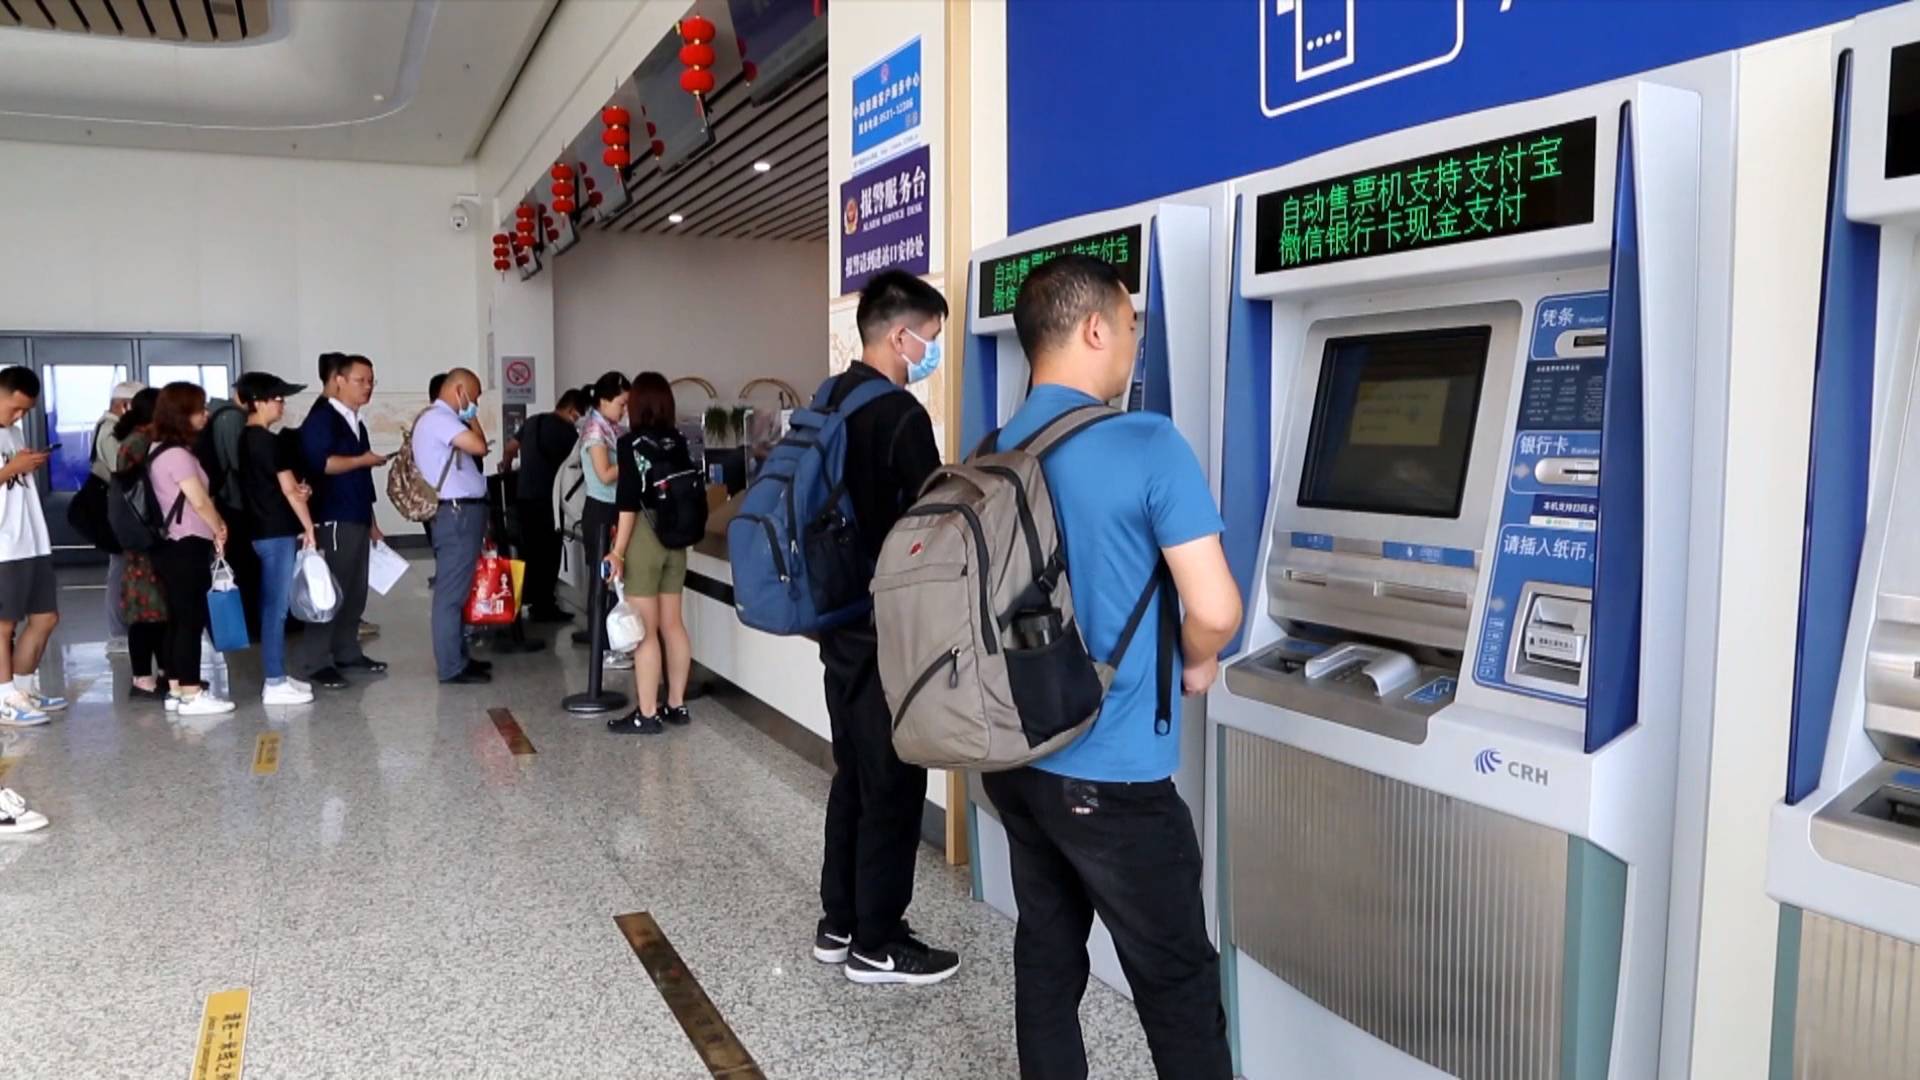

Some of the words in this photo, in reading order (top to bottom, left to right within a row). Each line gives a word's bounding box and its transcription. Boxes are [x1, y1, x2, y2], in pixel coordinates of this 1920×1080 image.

[860, 165, 926, 220] 报警服务台
[1281, 136, 1563, 231] 自动售票机支持支付宝
[882, 208, 905, 225] SERVICE
[1279, 184, 1527, 267] 微信银行卡现金支付
[1541, 307, 1575, 328] 凭条
[1519, 435, 1569, 456] 银行卡
[1503, 534, 1588, 561] 请插入纸币
[1507, 760, 1549, 786] CRH
